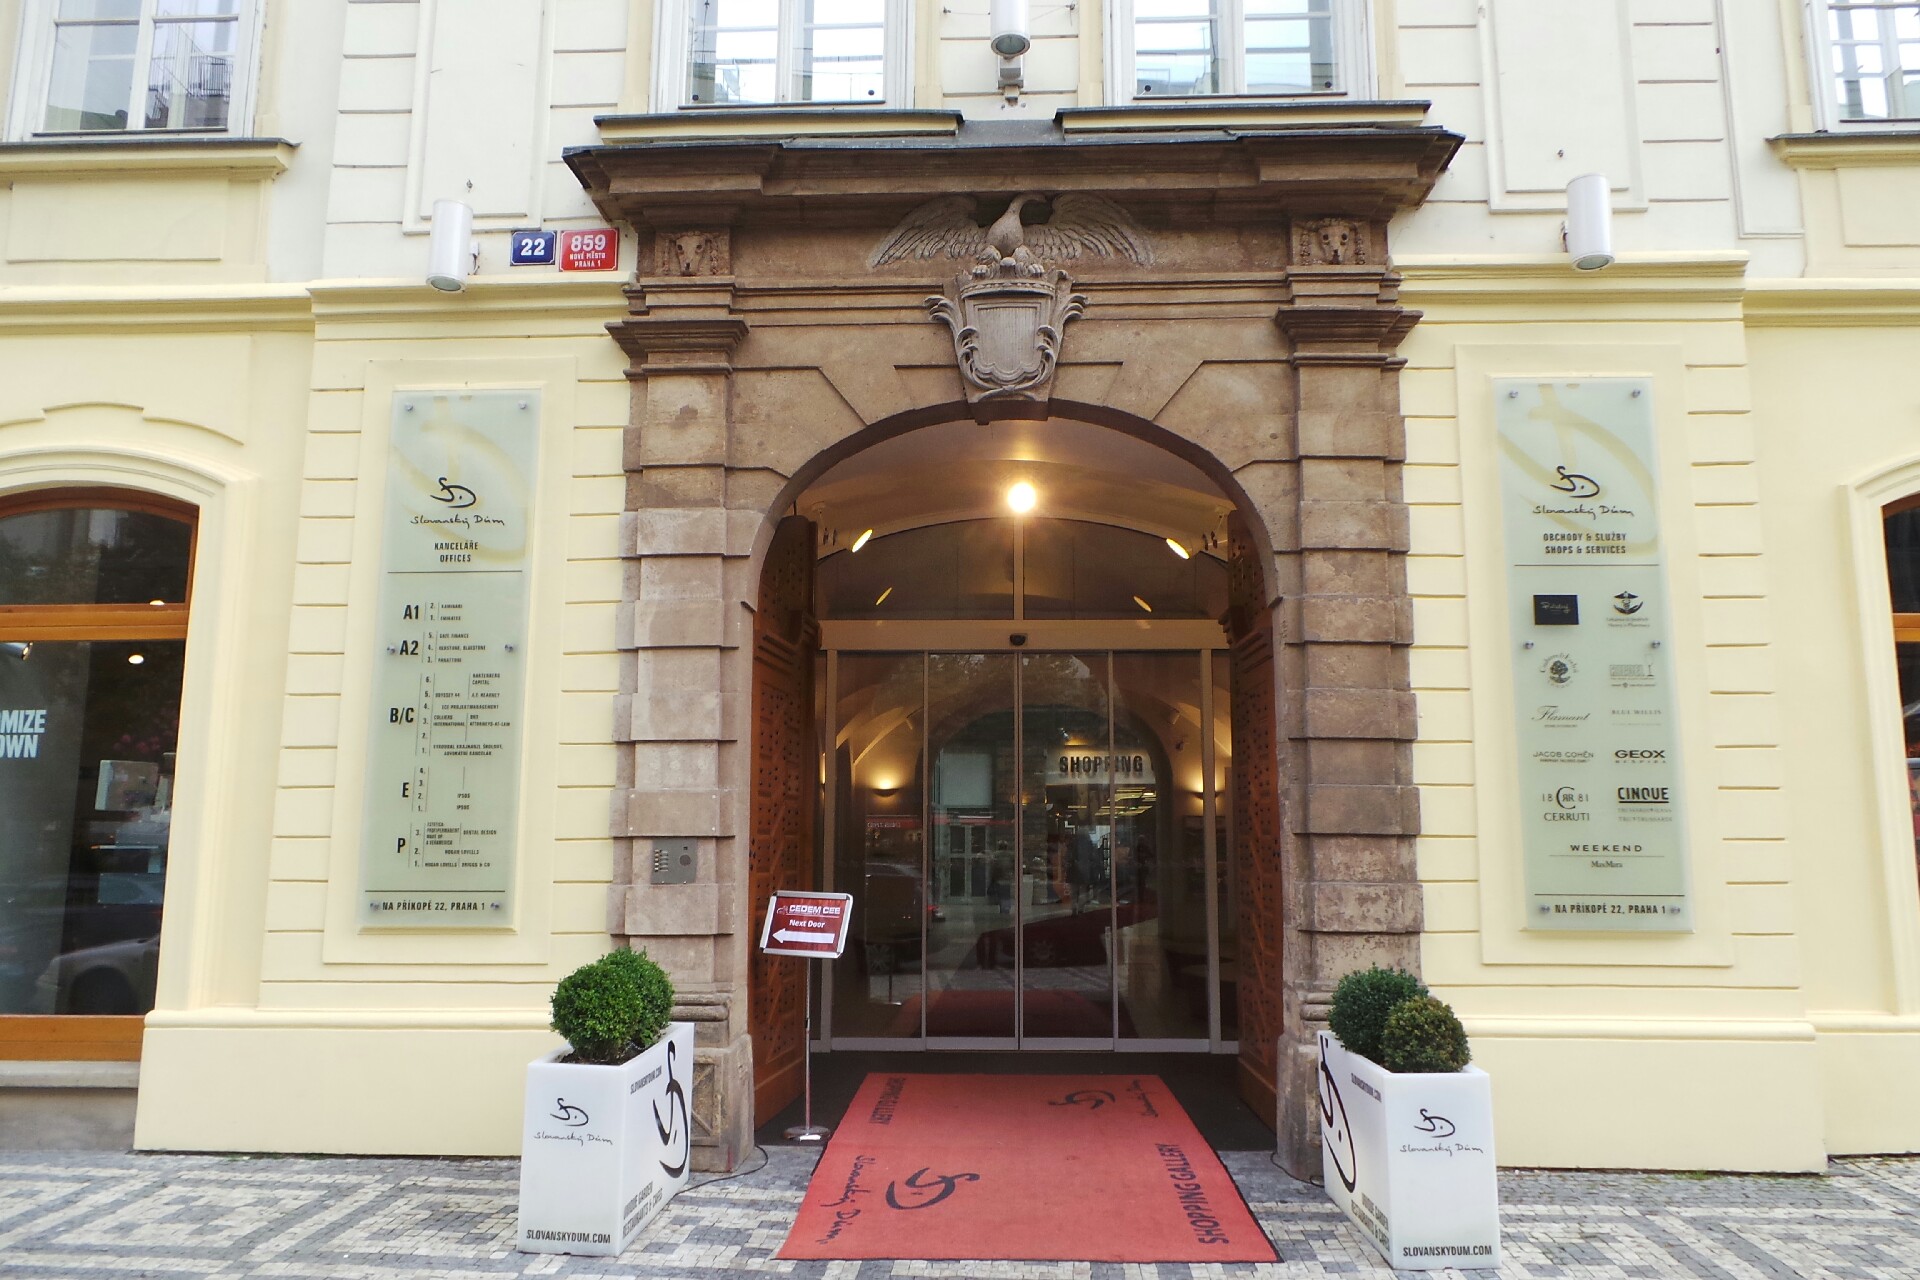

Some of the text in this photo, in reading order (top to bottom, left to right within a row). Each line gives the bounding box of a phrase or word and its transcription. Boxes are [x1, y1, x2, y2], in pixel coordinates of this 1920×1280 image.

[521, 238, 545, 256] 22
[571, 234, 606, 252] 859
[570, 252, 584, 260] NOVÉ
[1544, 533, 1582, 541] OBCHODY
[1596, 531, 1626, 541] SLUŽBY
[434, 540, 478, 550] KANCELÁŘE
[440, 554, 471, 562] OFFICES
[403, 605, 419, 620] A1
[400, 640, 418, 655] A2
[390, 708, 414, 725] B/C
[1532, 706, 1590, 721] Flamant
[0, 710, 47, 733] MIZE
[1614, 750, 1666, 758] GEOX
[1060, 756, 1143, 772] SHOPPING
[402, 782, 409, 798] E
[1618, 787, 1669, 800] CINQUE
[1544, 812, 1590, 822] CERRUTI
[398, 838, 406, 853] P
[382, 902, 393, 910] NA
[434, 902, 447, 911] 22,
[450, 902, 478, 910] PRAHA
[1555, 905, 1567, 913] NA
[1611, 905, 1625, 914] 22,
[1628, 905, 1658, 914] PRAHA
[1155, 1142, 1229, 1244] SHOPPING GALLERY
[526, 1229, 611, 1244] SLOVANSKYDUM.COM
[1403, 1246, 1492, 1257] SLOVANSKYDUM.COM
